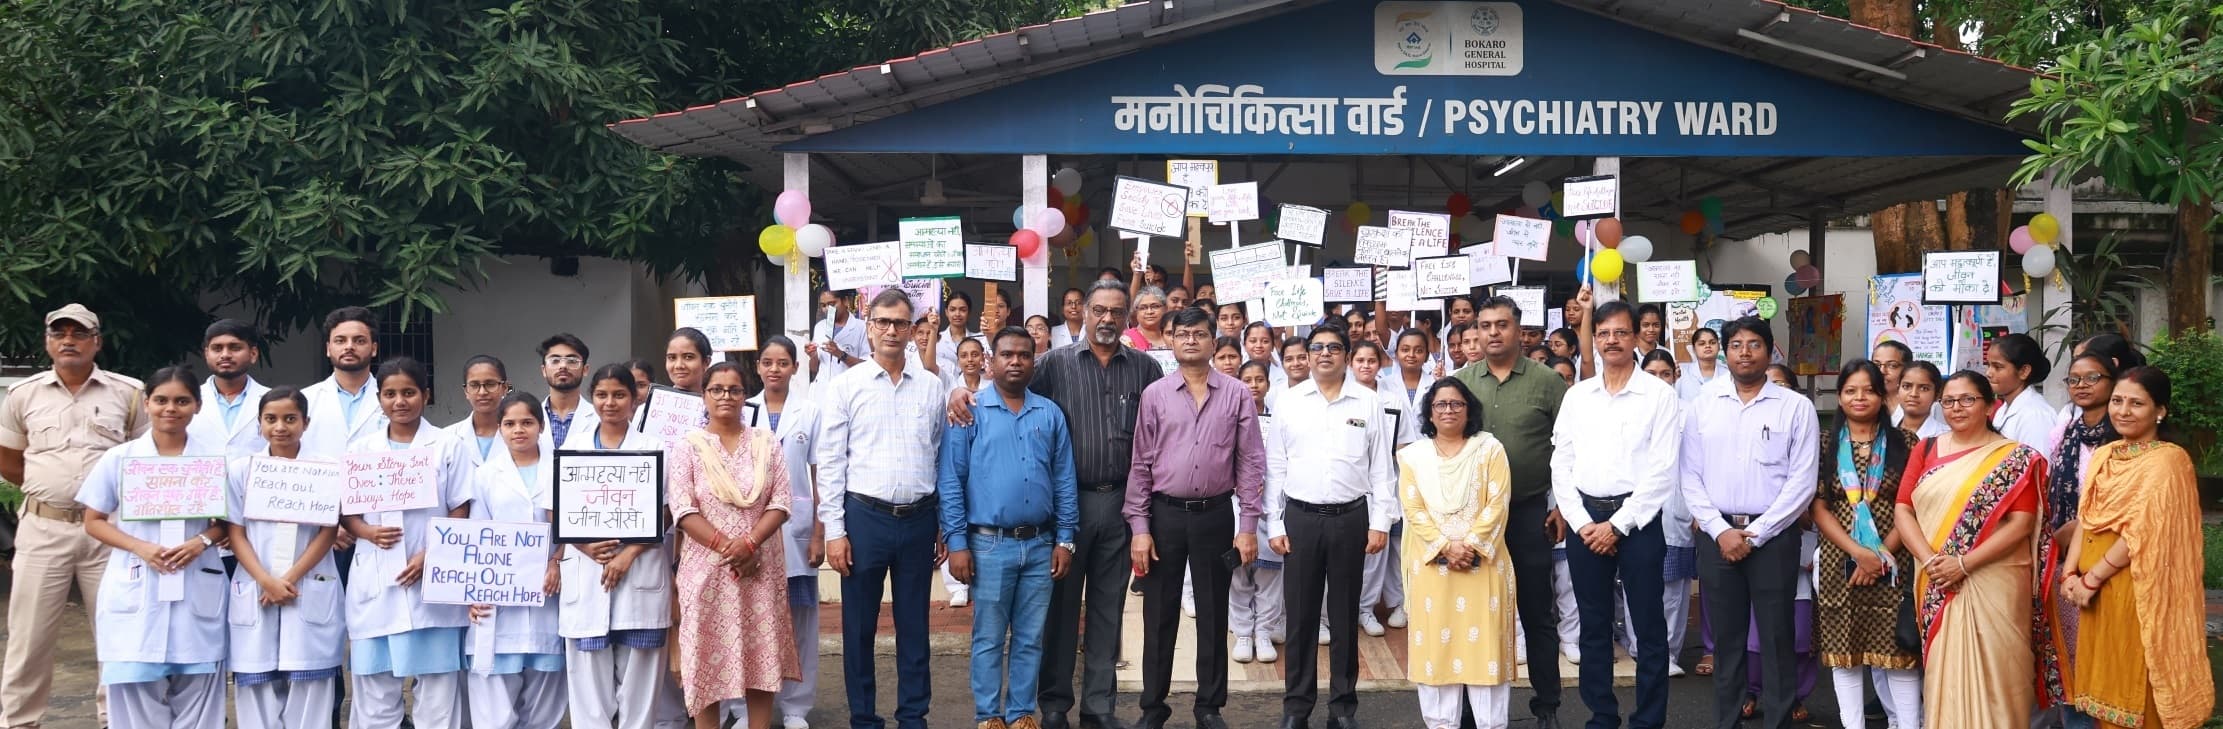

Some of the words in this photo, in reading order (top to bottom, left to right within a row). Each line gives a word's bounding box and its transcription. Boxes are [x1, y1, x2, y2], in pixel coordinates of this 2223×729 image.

[1464, 40, 1506, 49] BOKARO
[1464, 51, 1506, 59] GENERAL
[1464, 61, 1506, 69] HOSPITAL
[1112, 84, 1338, 135] मनोचिकित्सा
[1344, 87, 1407, 136] वार्ड
[1417, 98, 1432, 137] /
[1445, 99, 1662, 136] PSYCHIATRY
[1675, 101, 1778, 136] WARD
[1391, 215, 1416, 227] BREAK
[1417, 218, 1431, 228] THE
[1412, 228, 1443, 237] ILENCE
[1427, 238, 1447, 248] LIFE
[1930, 259, 1948, 269] आप
[1356, 269, 1368, 278] THE
[1947, 270, 1975, 281] जीवन
[1325, 289, 1343, 298] SAVE
[1355, 289, 1369, 297] LIFE
[667, 412, 690, 425] YOUR
[659, 425, 678, 436] ASK
[255, 461, 278, 473] You
[281, 465, 299, 473] are
[346, 459, 372, 475] Your
[377, 456, 406, 476] Story
[349, 476, 376, 489] Over
[387, 472, 424, 486] There's
[562, 465, 626, 483] आत्महत्या
[253, 476, 287, 490] Reach
[347, 490, 384, 510] always
[391, 489, 416, 504] Hope
[581, 484, 637, 506] जीवन
[267, 496, 305, 510] Reach
[310, 500, 336, 512] Hope
[568, 505, 601, 527] जीना
[435, 526, 470, 545] YOU
[480, 527, 507, 546] ARE
[515, 531, 544, 547] NOT
[464, 544, 512, 566] ALONE
[431, 567, 476, 584] REACH
[481, 567, 515, 586] OUT
[464, 584, 509, 602] REACH
[513, 586, 541, 603] HOPE
